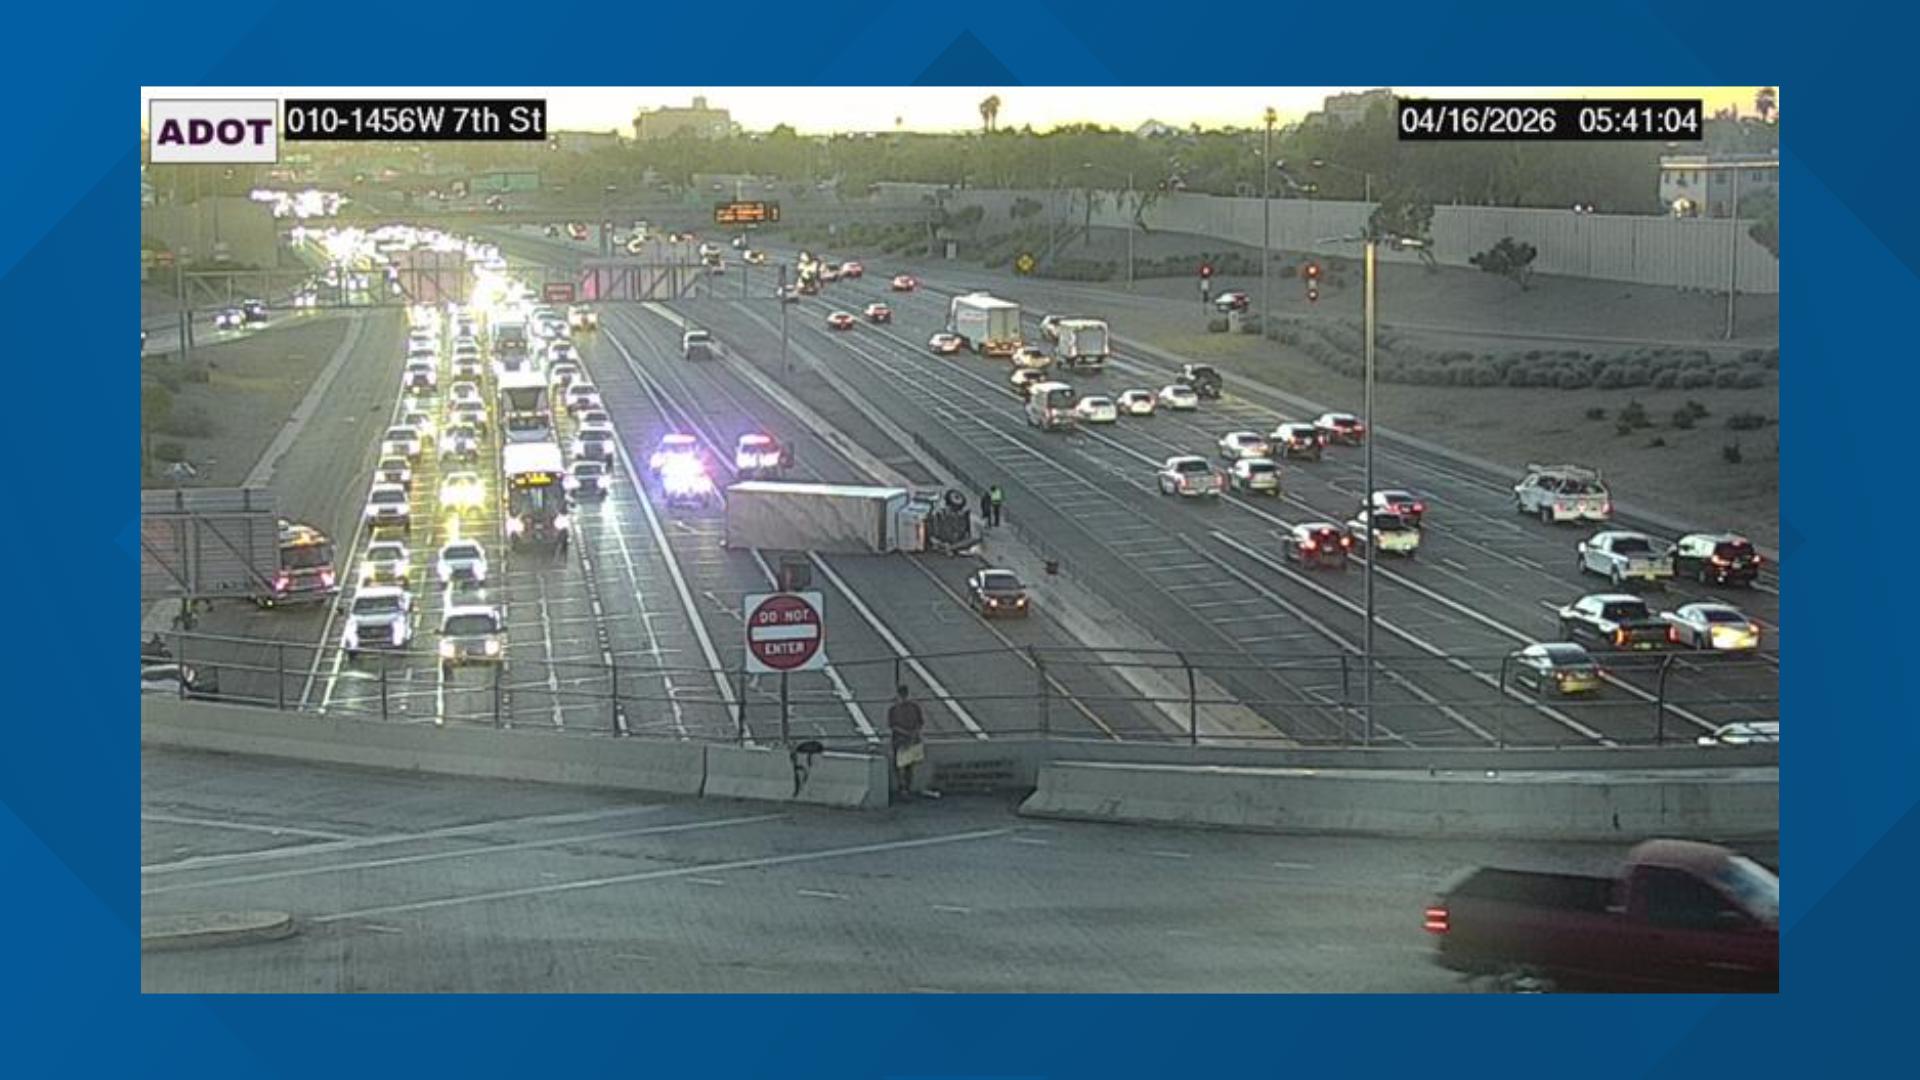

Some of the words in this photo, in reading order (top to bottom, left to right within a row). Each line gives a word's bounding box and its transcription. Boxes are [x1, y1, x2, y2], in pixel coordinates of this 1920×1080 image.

[759, 610, 777, 623] DO
[785, 608, 809, 622] NOT
[765, 641, 804, 655] ENTER
